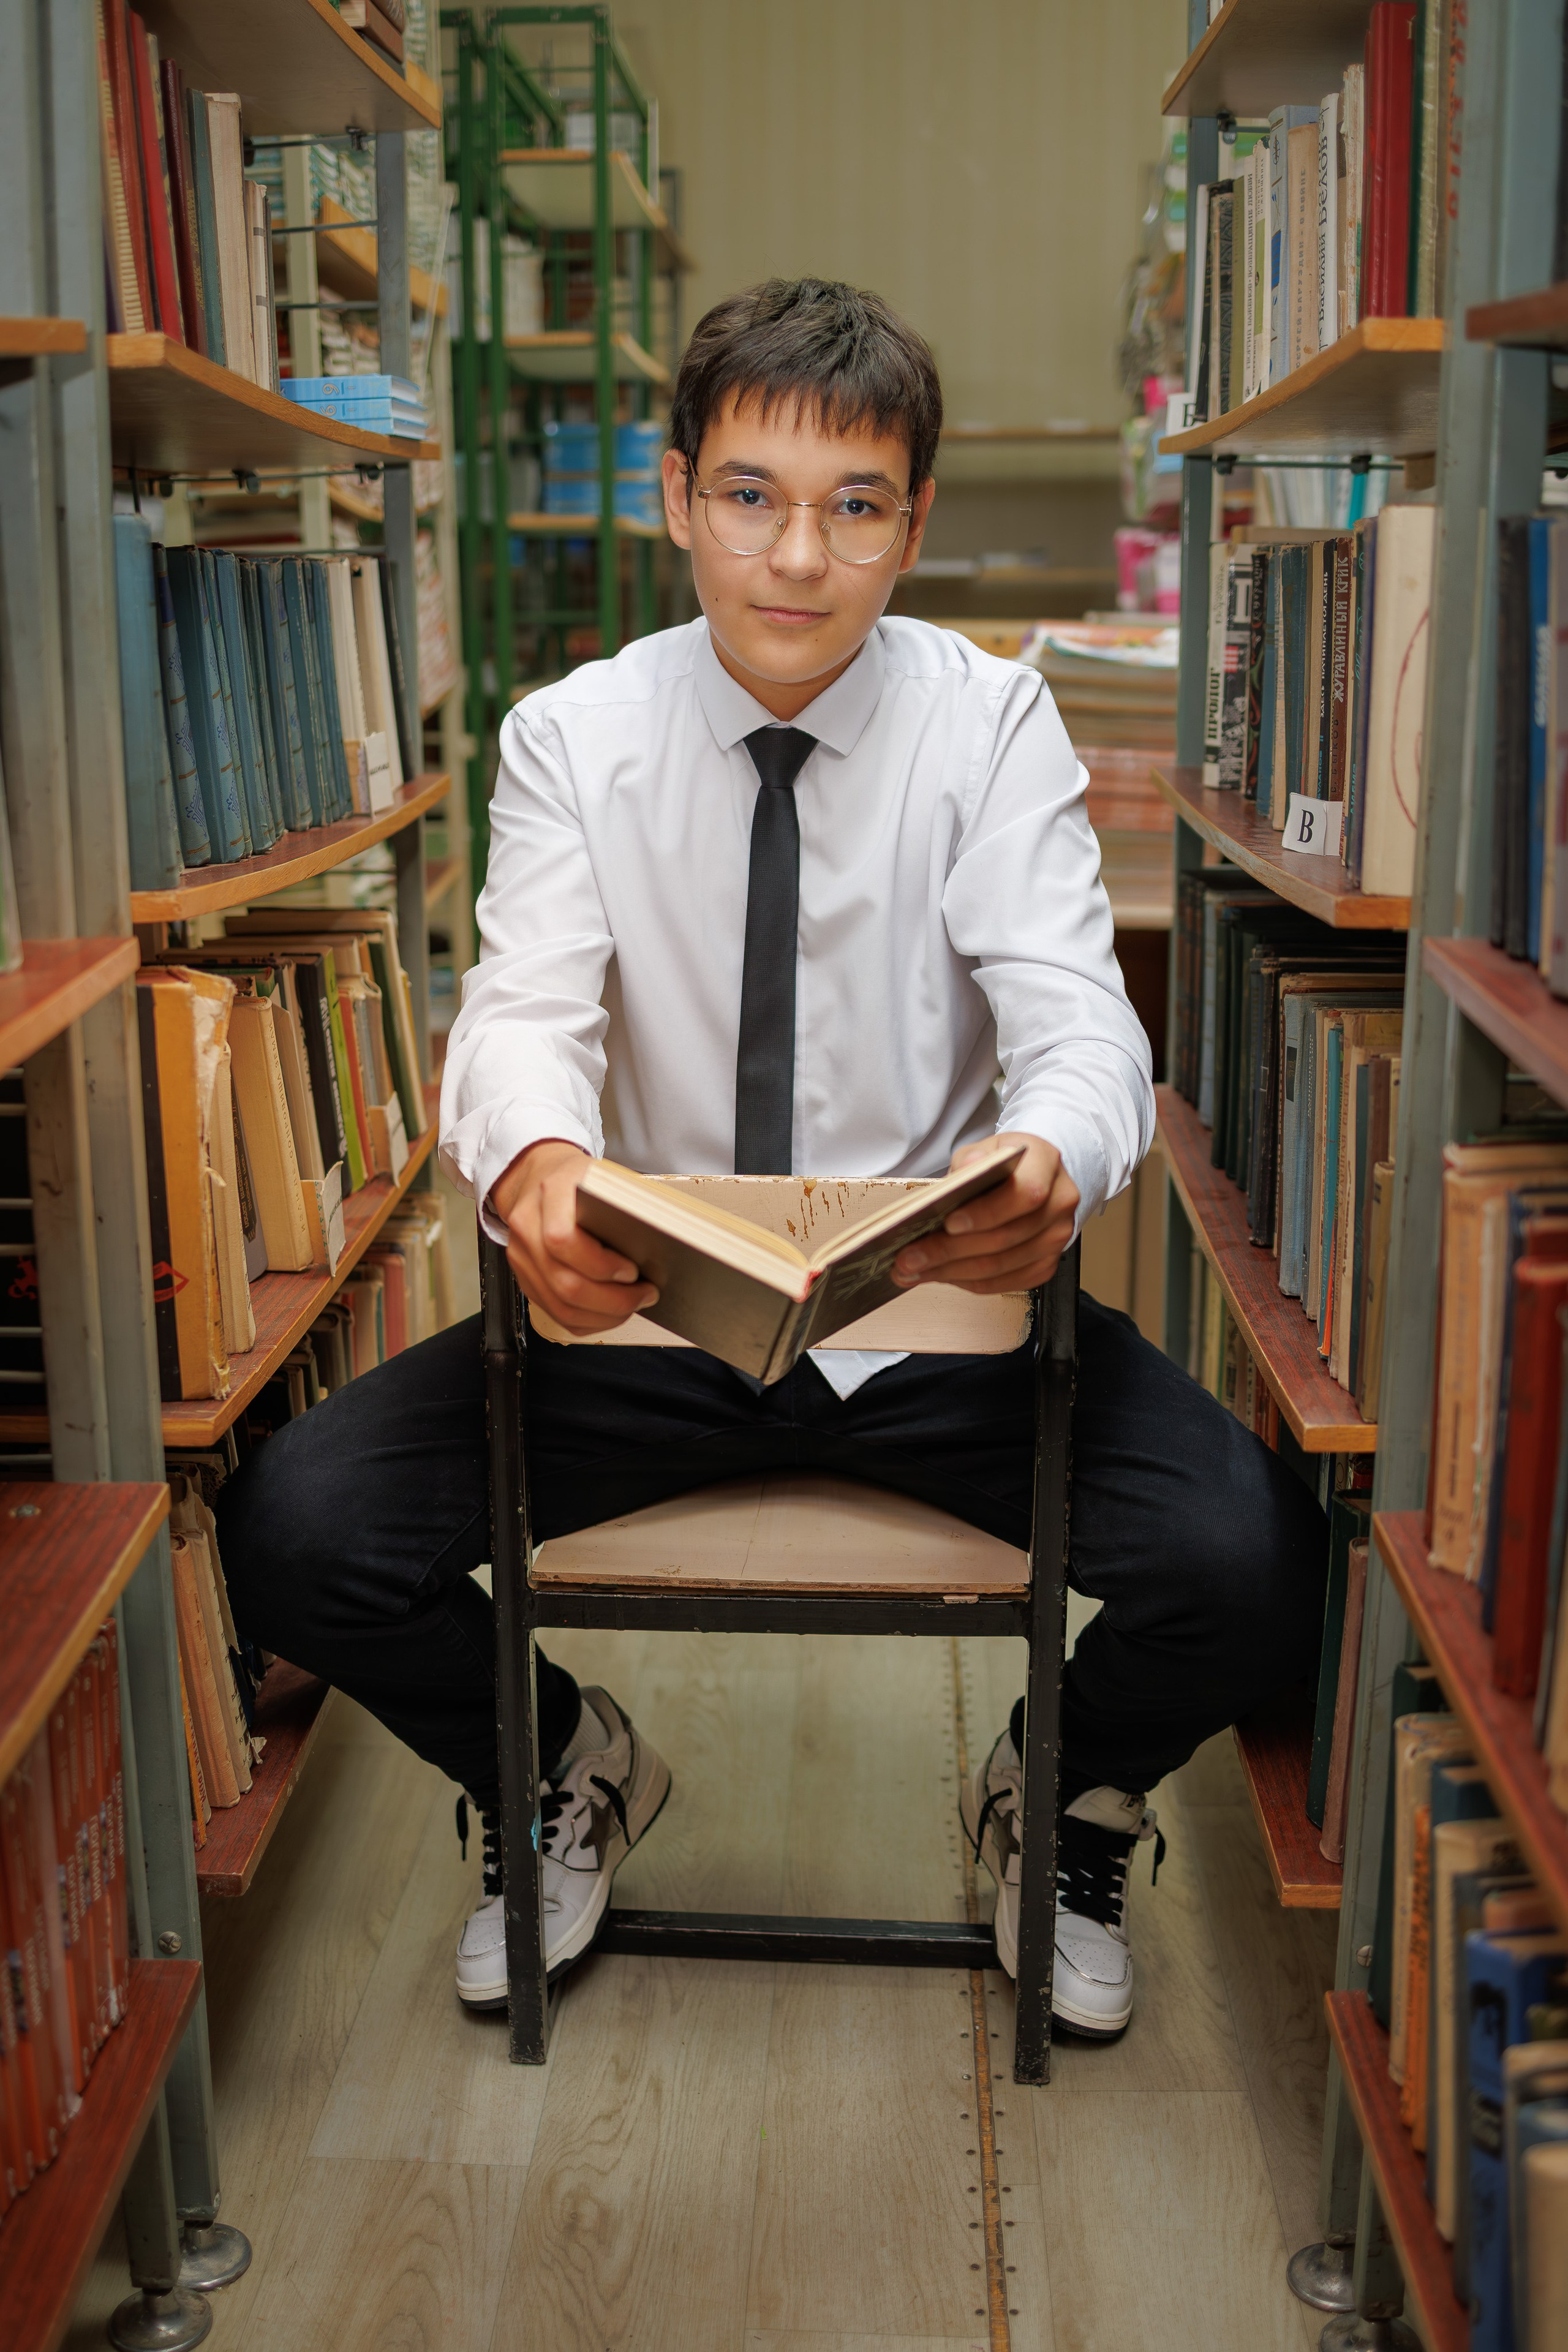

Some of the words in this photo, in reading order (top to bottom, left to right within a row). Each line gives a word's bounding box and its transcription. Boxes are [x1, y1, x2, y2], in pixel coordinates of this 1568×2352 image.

[1317, 135, 1328, 227] Белов
[1336, 557, 1349, 593] КРИК
[1333, 601, 1348, 703] ЖУРАВЛИНЫЙ
[1208, 666, 1221, 739] ПРОЛОГ
[268, 1022, 279, 1068] ЗЕМЛИ
[67, 1854, 81, 1943] ГЕОГРАФИЯ
[89, 1815, 102, 1902] ГЕОГРАФИЯ
